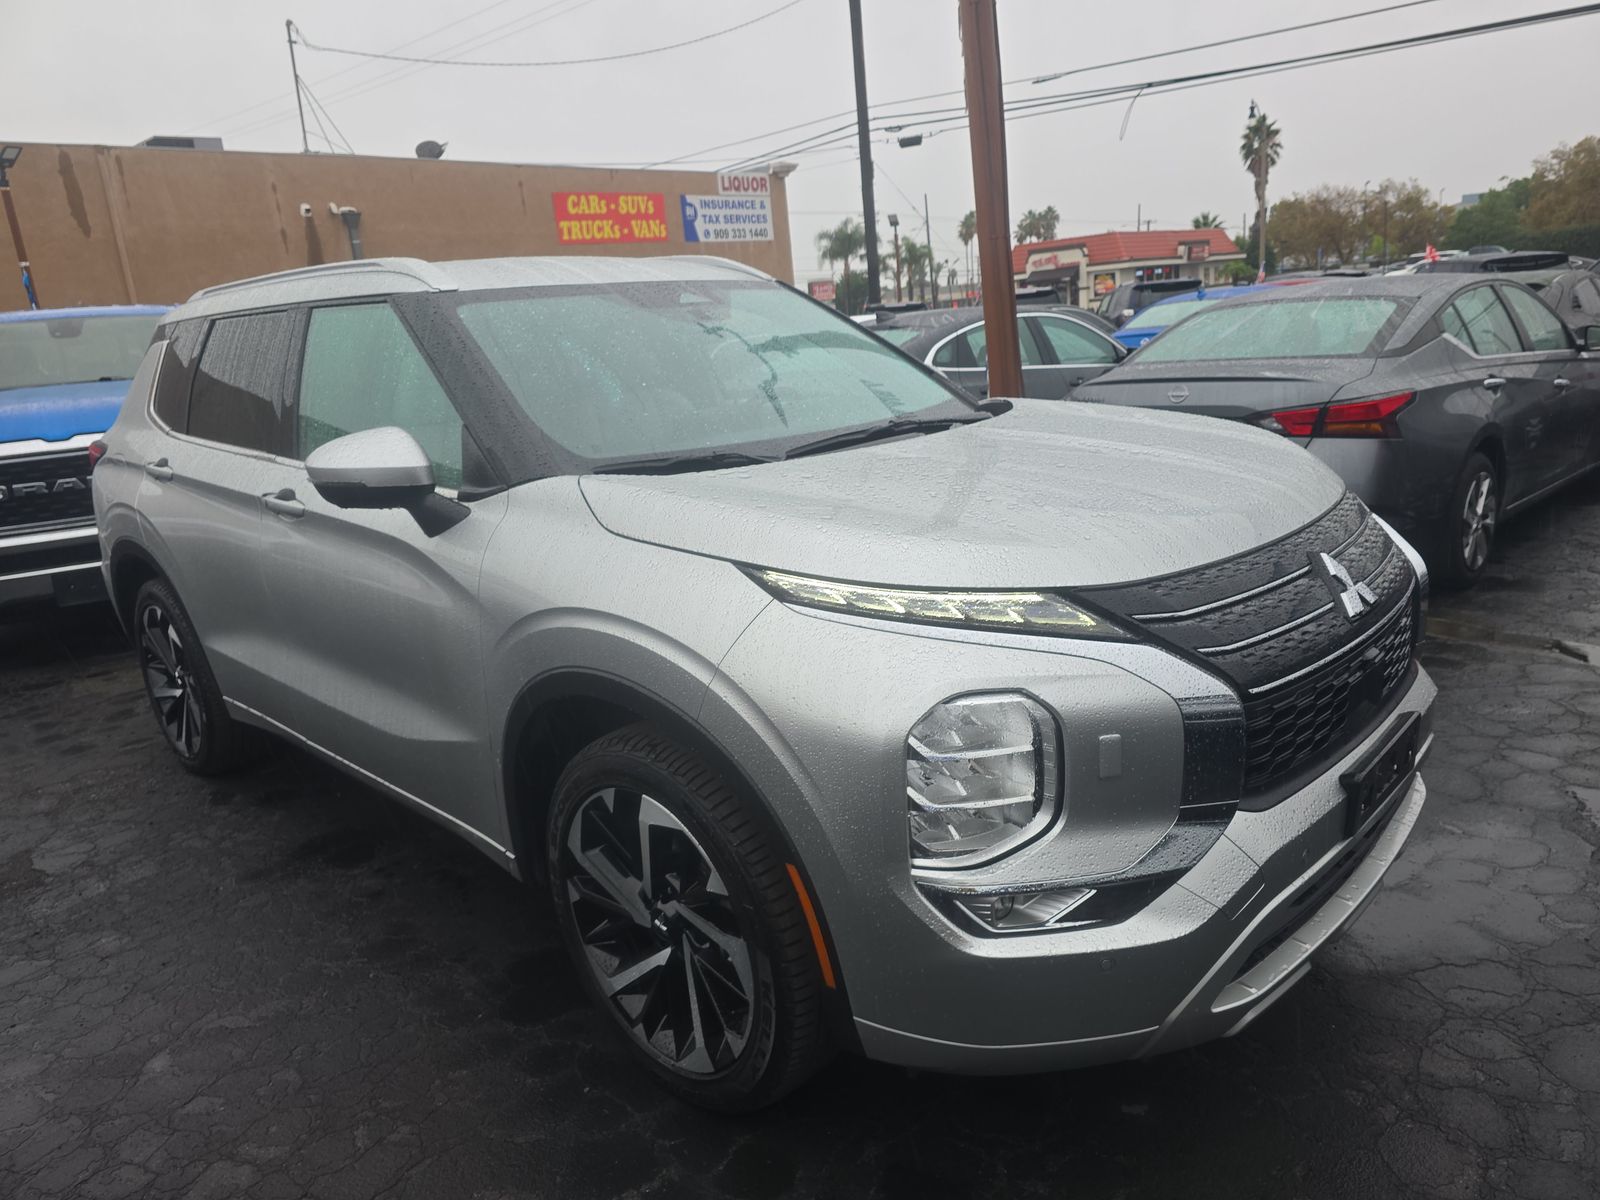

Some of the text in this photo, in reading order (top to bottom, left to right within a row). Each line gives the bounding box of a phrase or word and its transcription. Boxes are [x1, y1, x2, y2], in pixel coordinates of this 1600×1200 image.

[721, 175, 768, 192] LIQUOR
[700, 199, 766, 209] INSURANCE &
[702, 214, 768, 224] TAX SERVICES
[714, 227, 768, 239] 909 333 1440
